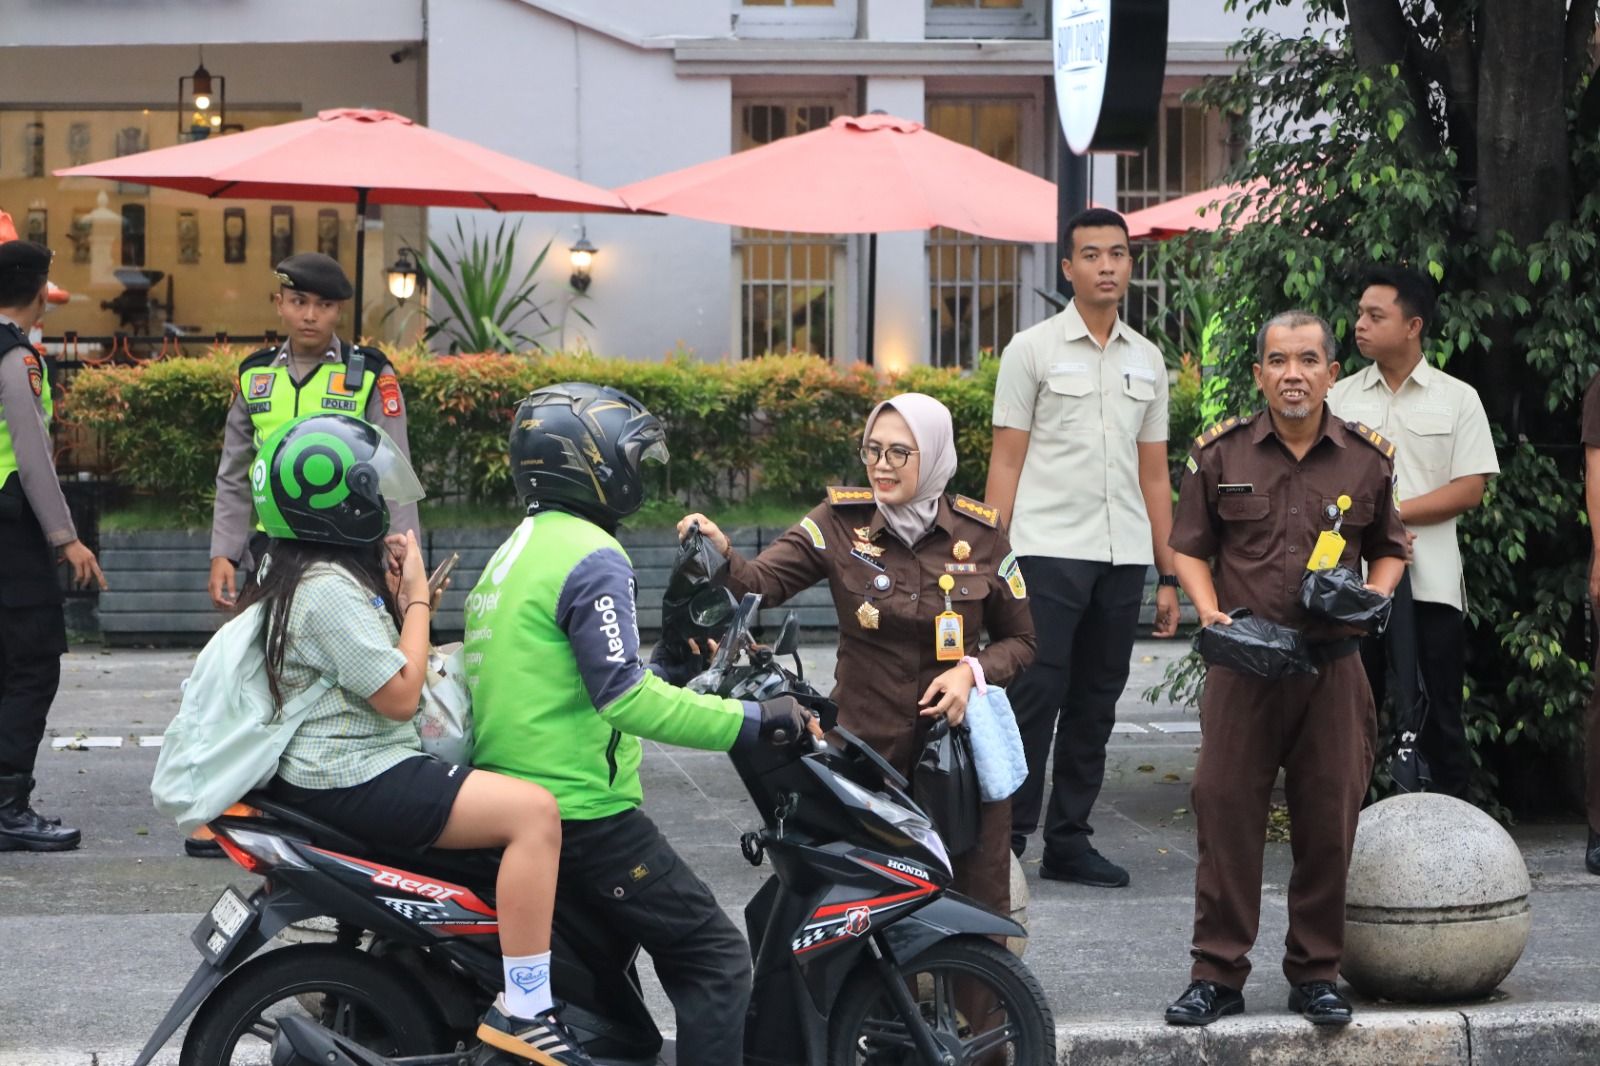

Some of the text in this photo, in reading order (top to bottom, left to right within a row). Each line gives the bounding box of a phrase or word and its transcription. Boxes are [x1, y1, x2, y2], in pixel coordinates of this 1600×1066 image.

[324, 398, 356, 411] POLRI
[594, 595, 626, 663] gopay
[887, 859, 930, 881] HONDA
